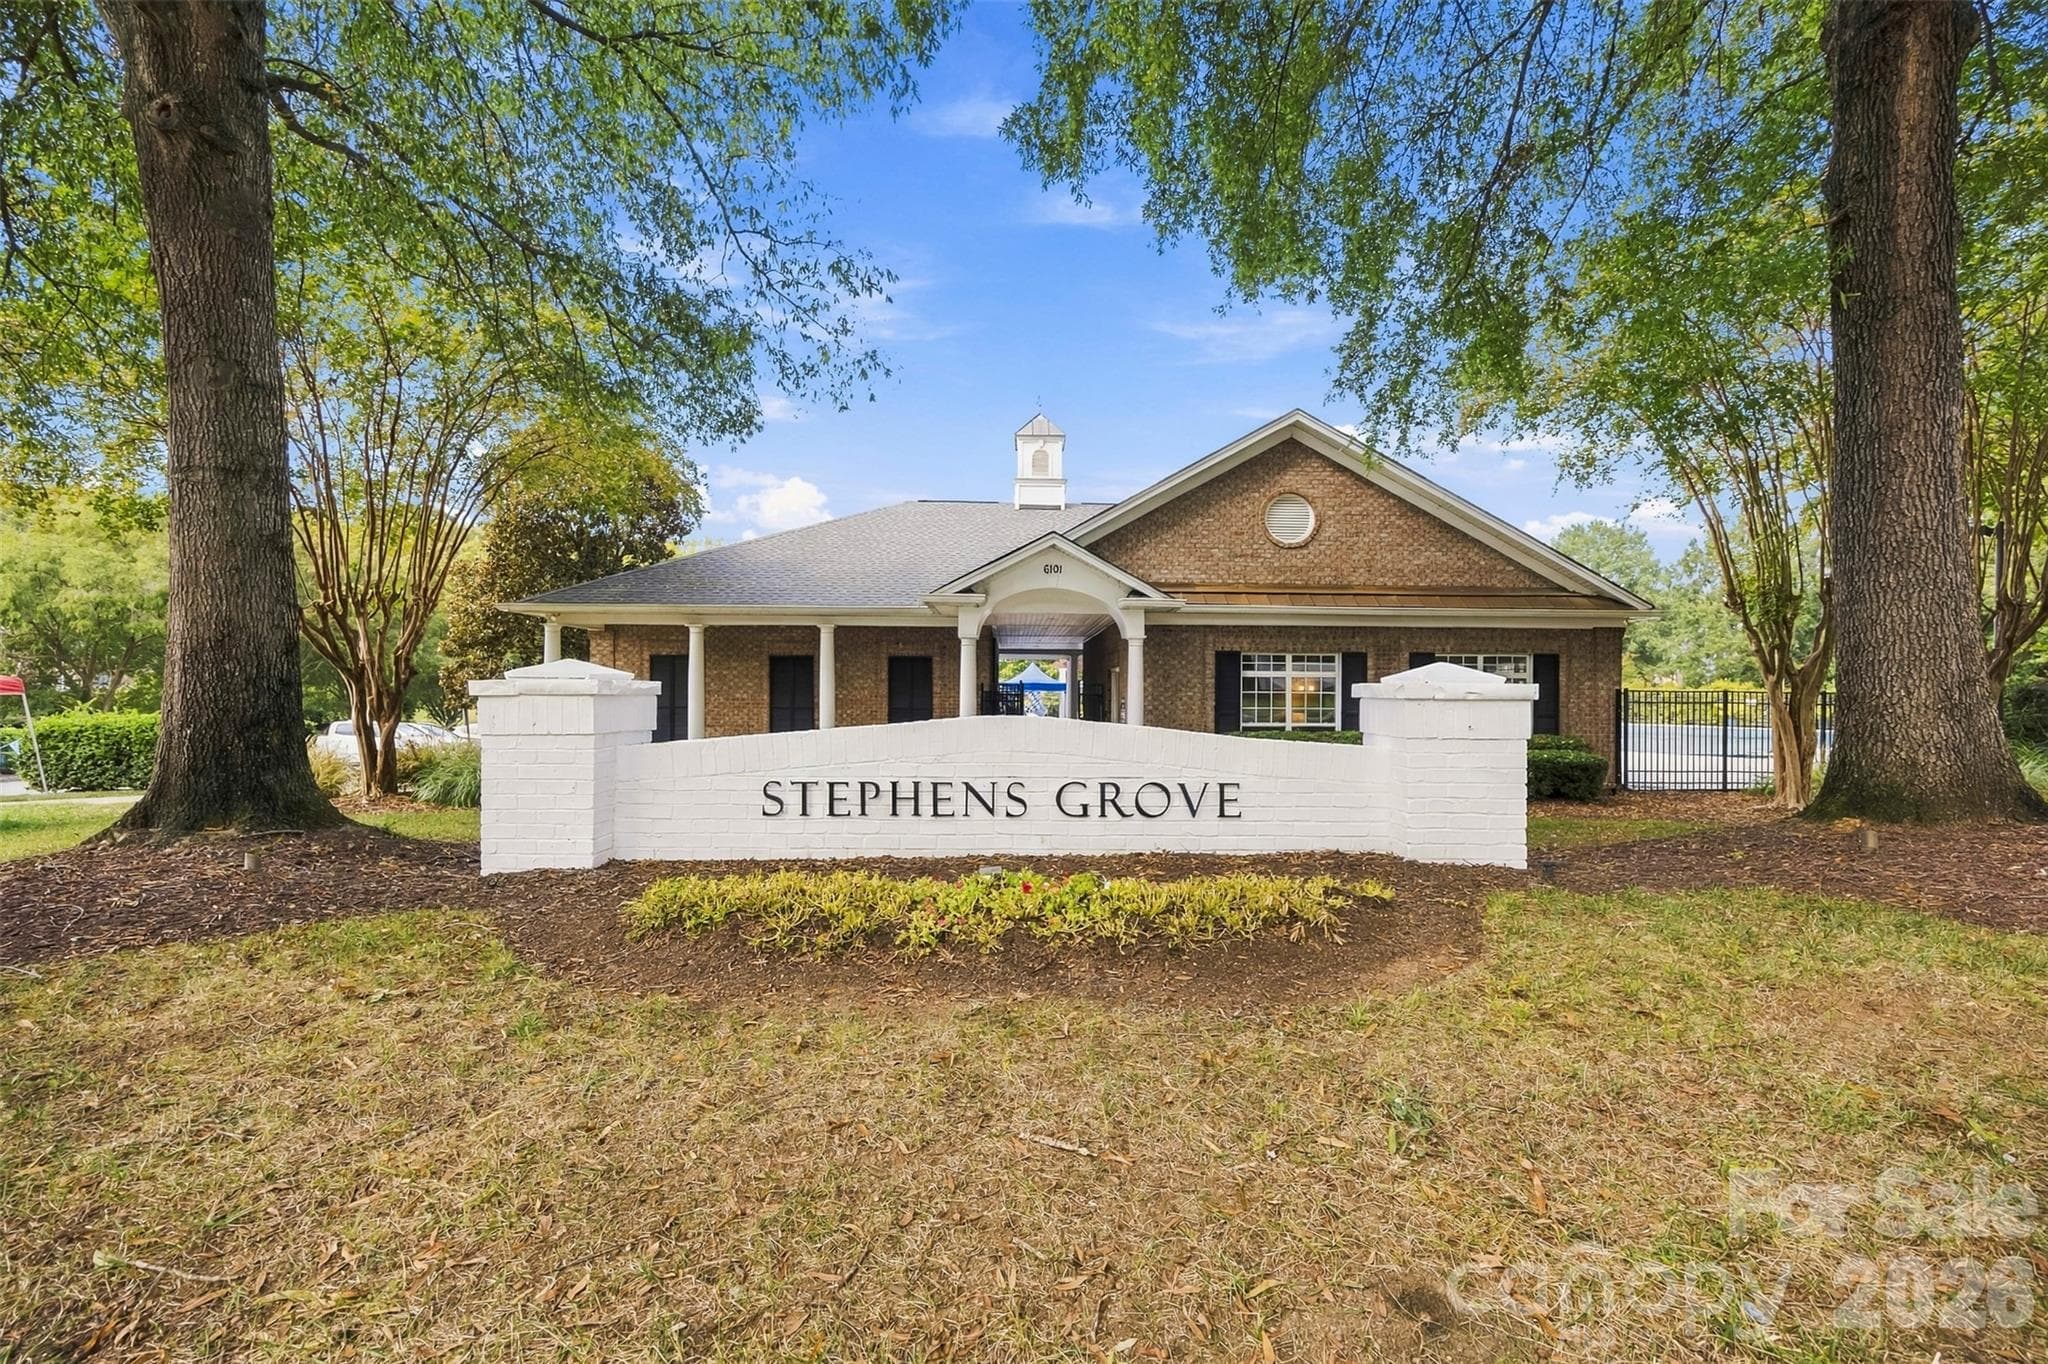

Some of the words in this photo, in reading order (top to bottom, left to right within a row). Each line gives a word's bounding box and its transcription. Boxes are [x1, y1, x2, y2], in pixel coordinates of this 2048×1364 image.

[1043, 564, 1062, 574] 6101
[761, 780, 1028, 817] STEPHENS
[1055, 780, 1242, 818] GROVE
